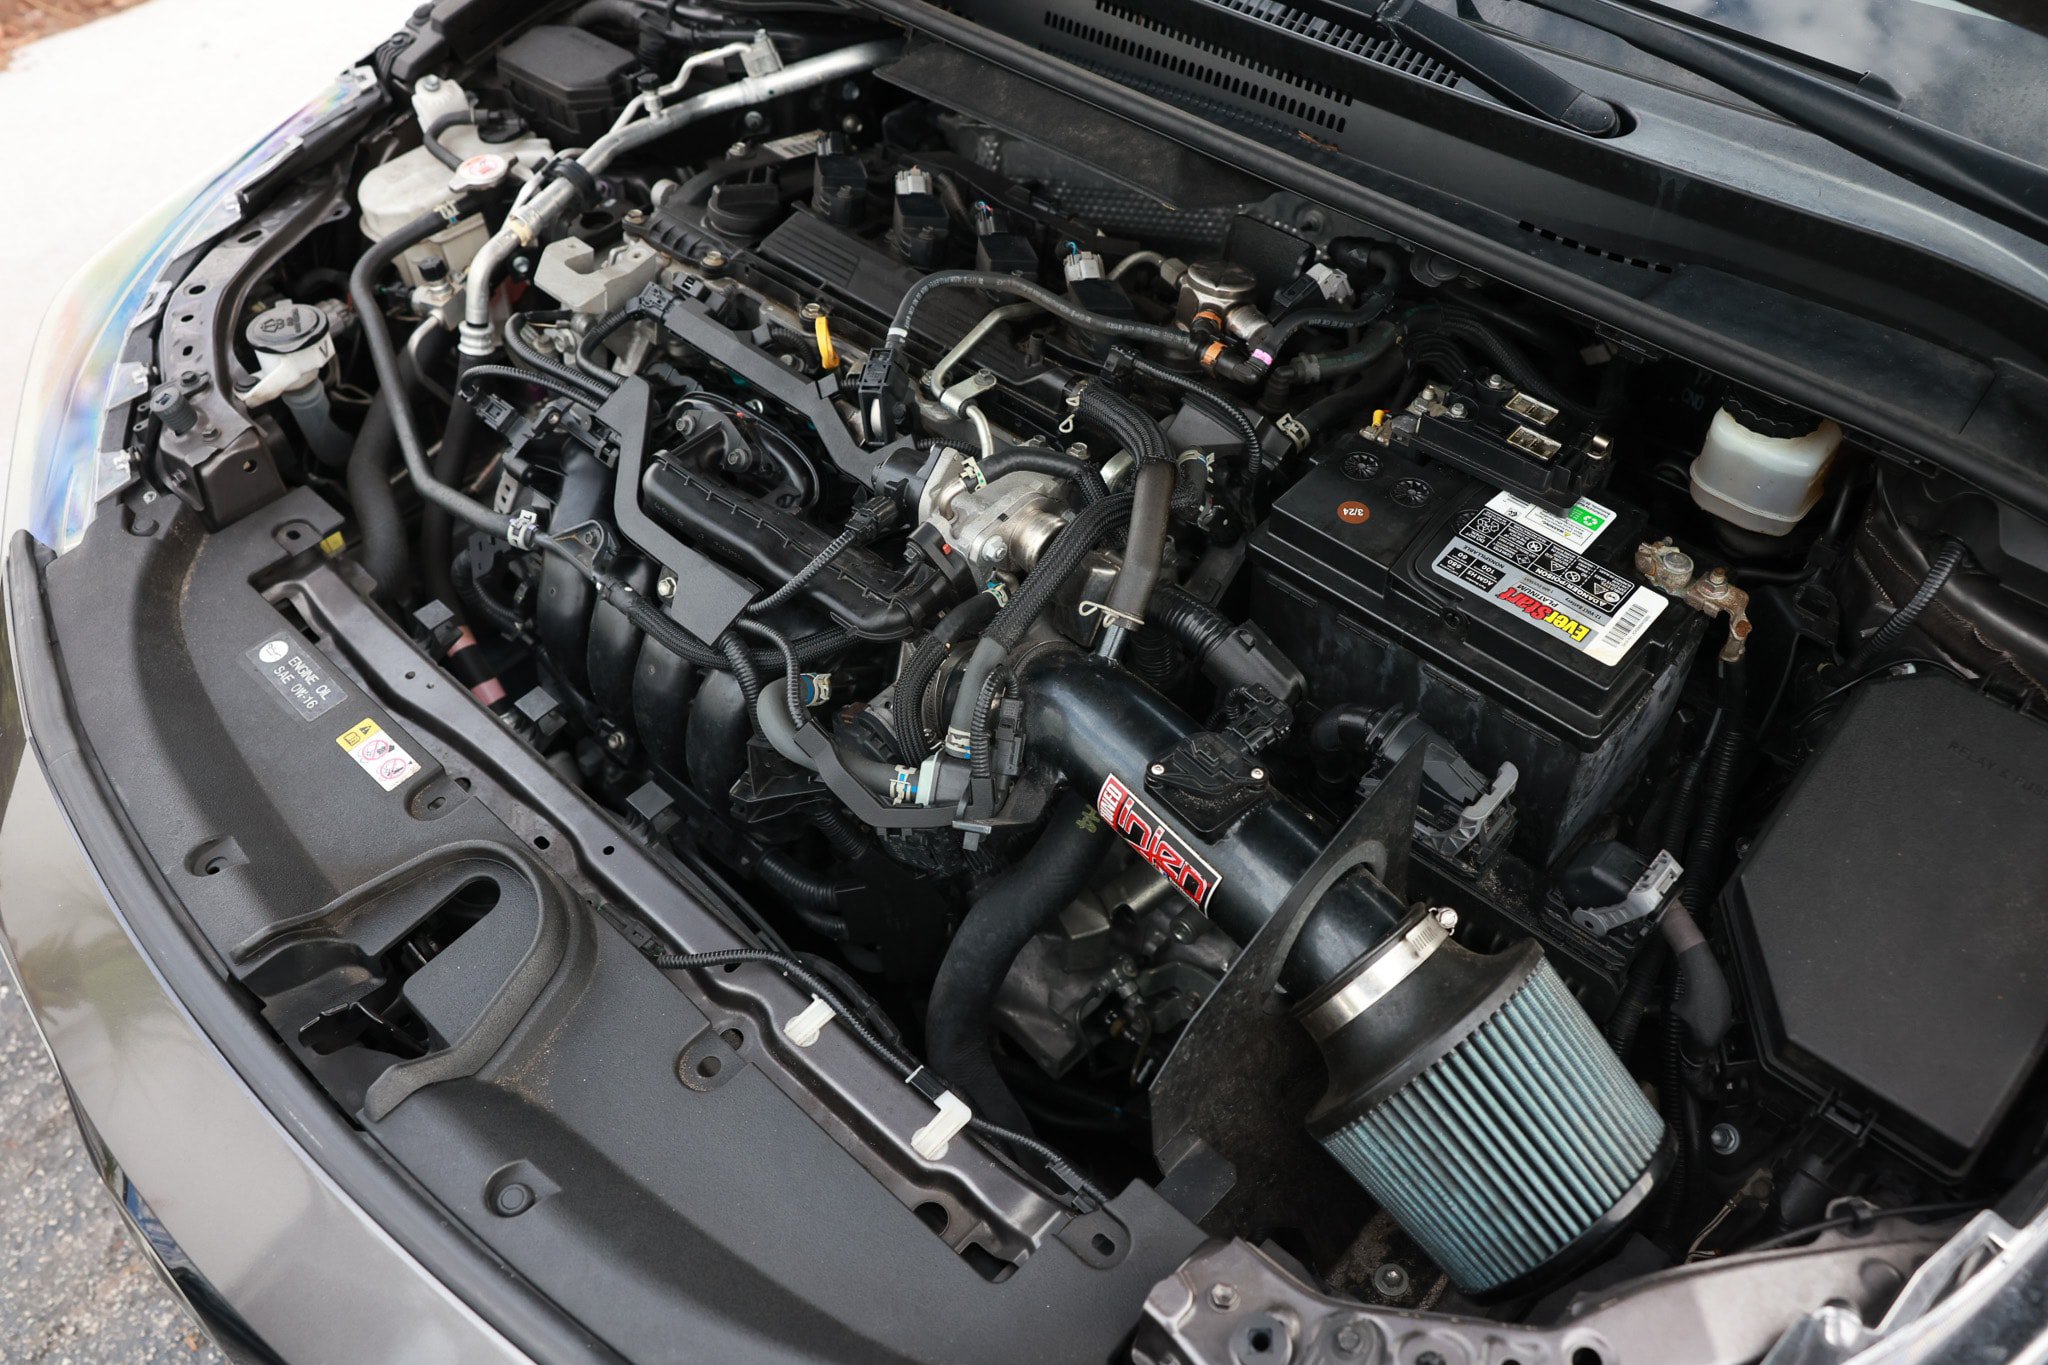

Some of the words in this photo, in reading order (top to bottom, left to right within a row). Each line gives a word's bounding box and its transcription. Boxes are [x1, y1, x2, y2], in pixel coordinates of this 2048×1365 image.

[1343, 508, 1363, 516] 3/24
[1446, 558, 1461, 569] 680
[1457, 551, 1468, 559] 60
[1462, 544, 1504, 568] NONSPILLABLE
[1480, 564, 1495, 574] 100
[1476, 574, 1493, 586] AGM
[1534, 567, 1599, 603] DANGER/POISON
[1516, 584, 1559, 607] PLATINUM
[1564, 597, 1582, 609] Battery
[1497, 587, 1592, 643] EverStart
[273, 666, 294, 684] SAE
[288, 656, 318, 685] ENGINE
[316, 684, 332, 700] OIL
[1118, 797, 1207, 902] injen
